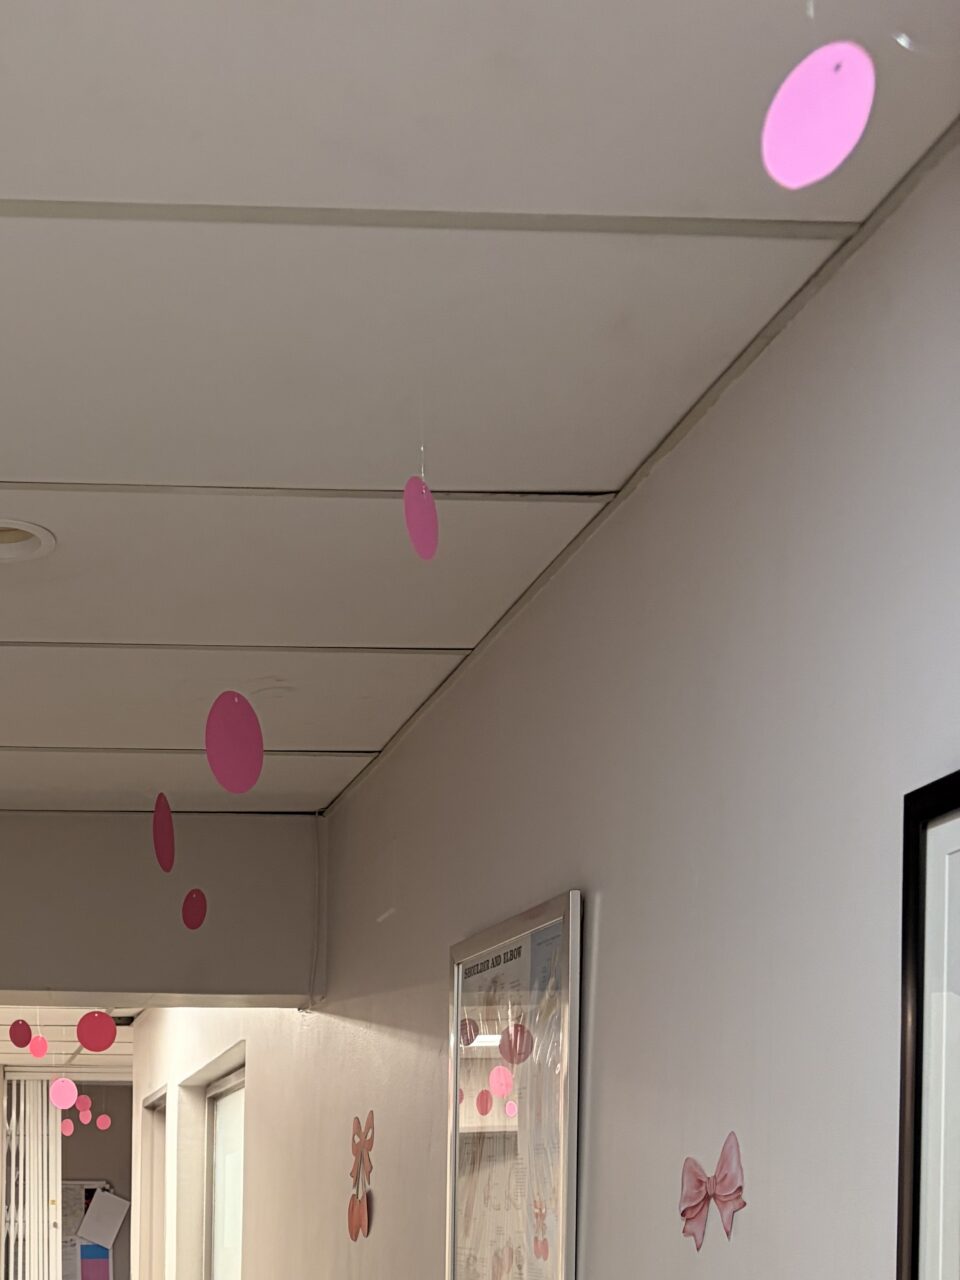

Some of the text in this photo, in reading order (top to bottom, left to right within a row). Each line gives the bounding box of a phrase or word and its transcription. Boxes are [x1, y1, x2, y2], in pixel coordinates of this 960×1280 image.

[464, 946, 522, 979] SHOULDER AND ELBOW
